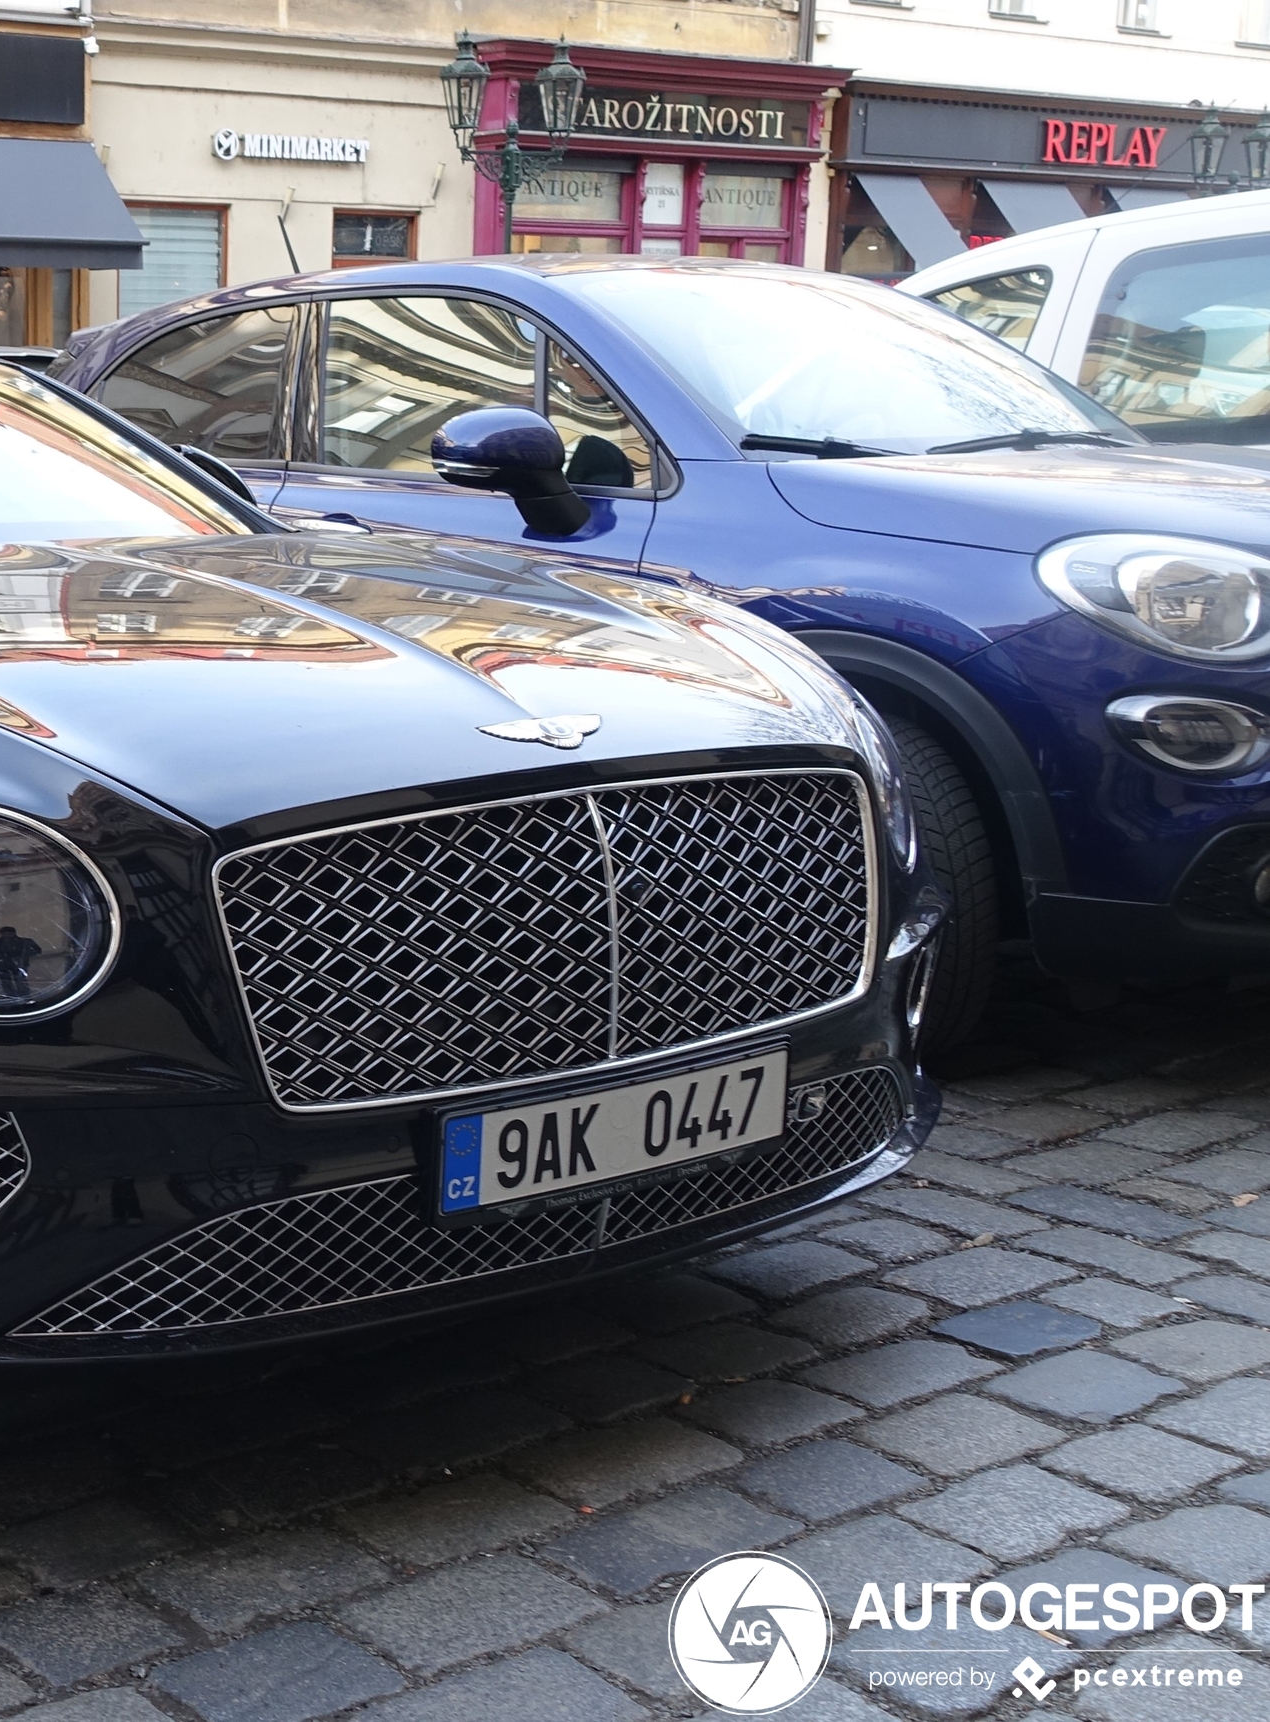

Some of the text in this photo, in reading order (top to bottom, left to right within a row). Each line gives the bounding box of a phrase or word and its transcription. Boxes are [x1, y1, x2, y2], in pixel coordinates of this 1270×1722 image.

[568, 94, 785, 139] TAROŽITNOSTI
[243, 133, 370, 162] MINIMARKET
[1042, 118, 1167, 169] REPLAY
[704, 187, 777, 210] ANTIQUE
[495, 1065, 765, 1189] 9AK 0447
[447, 1176, 476, 1199] CZ
